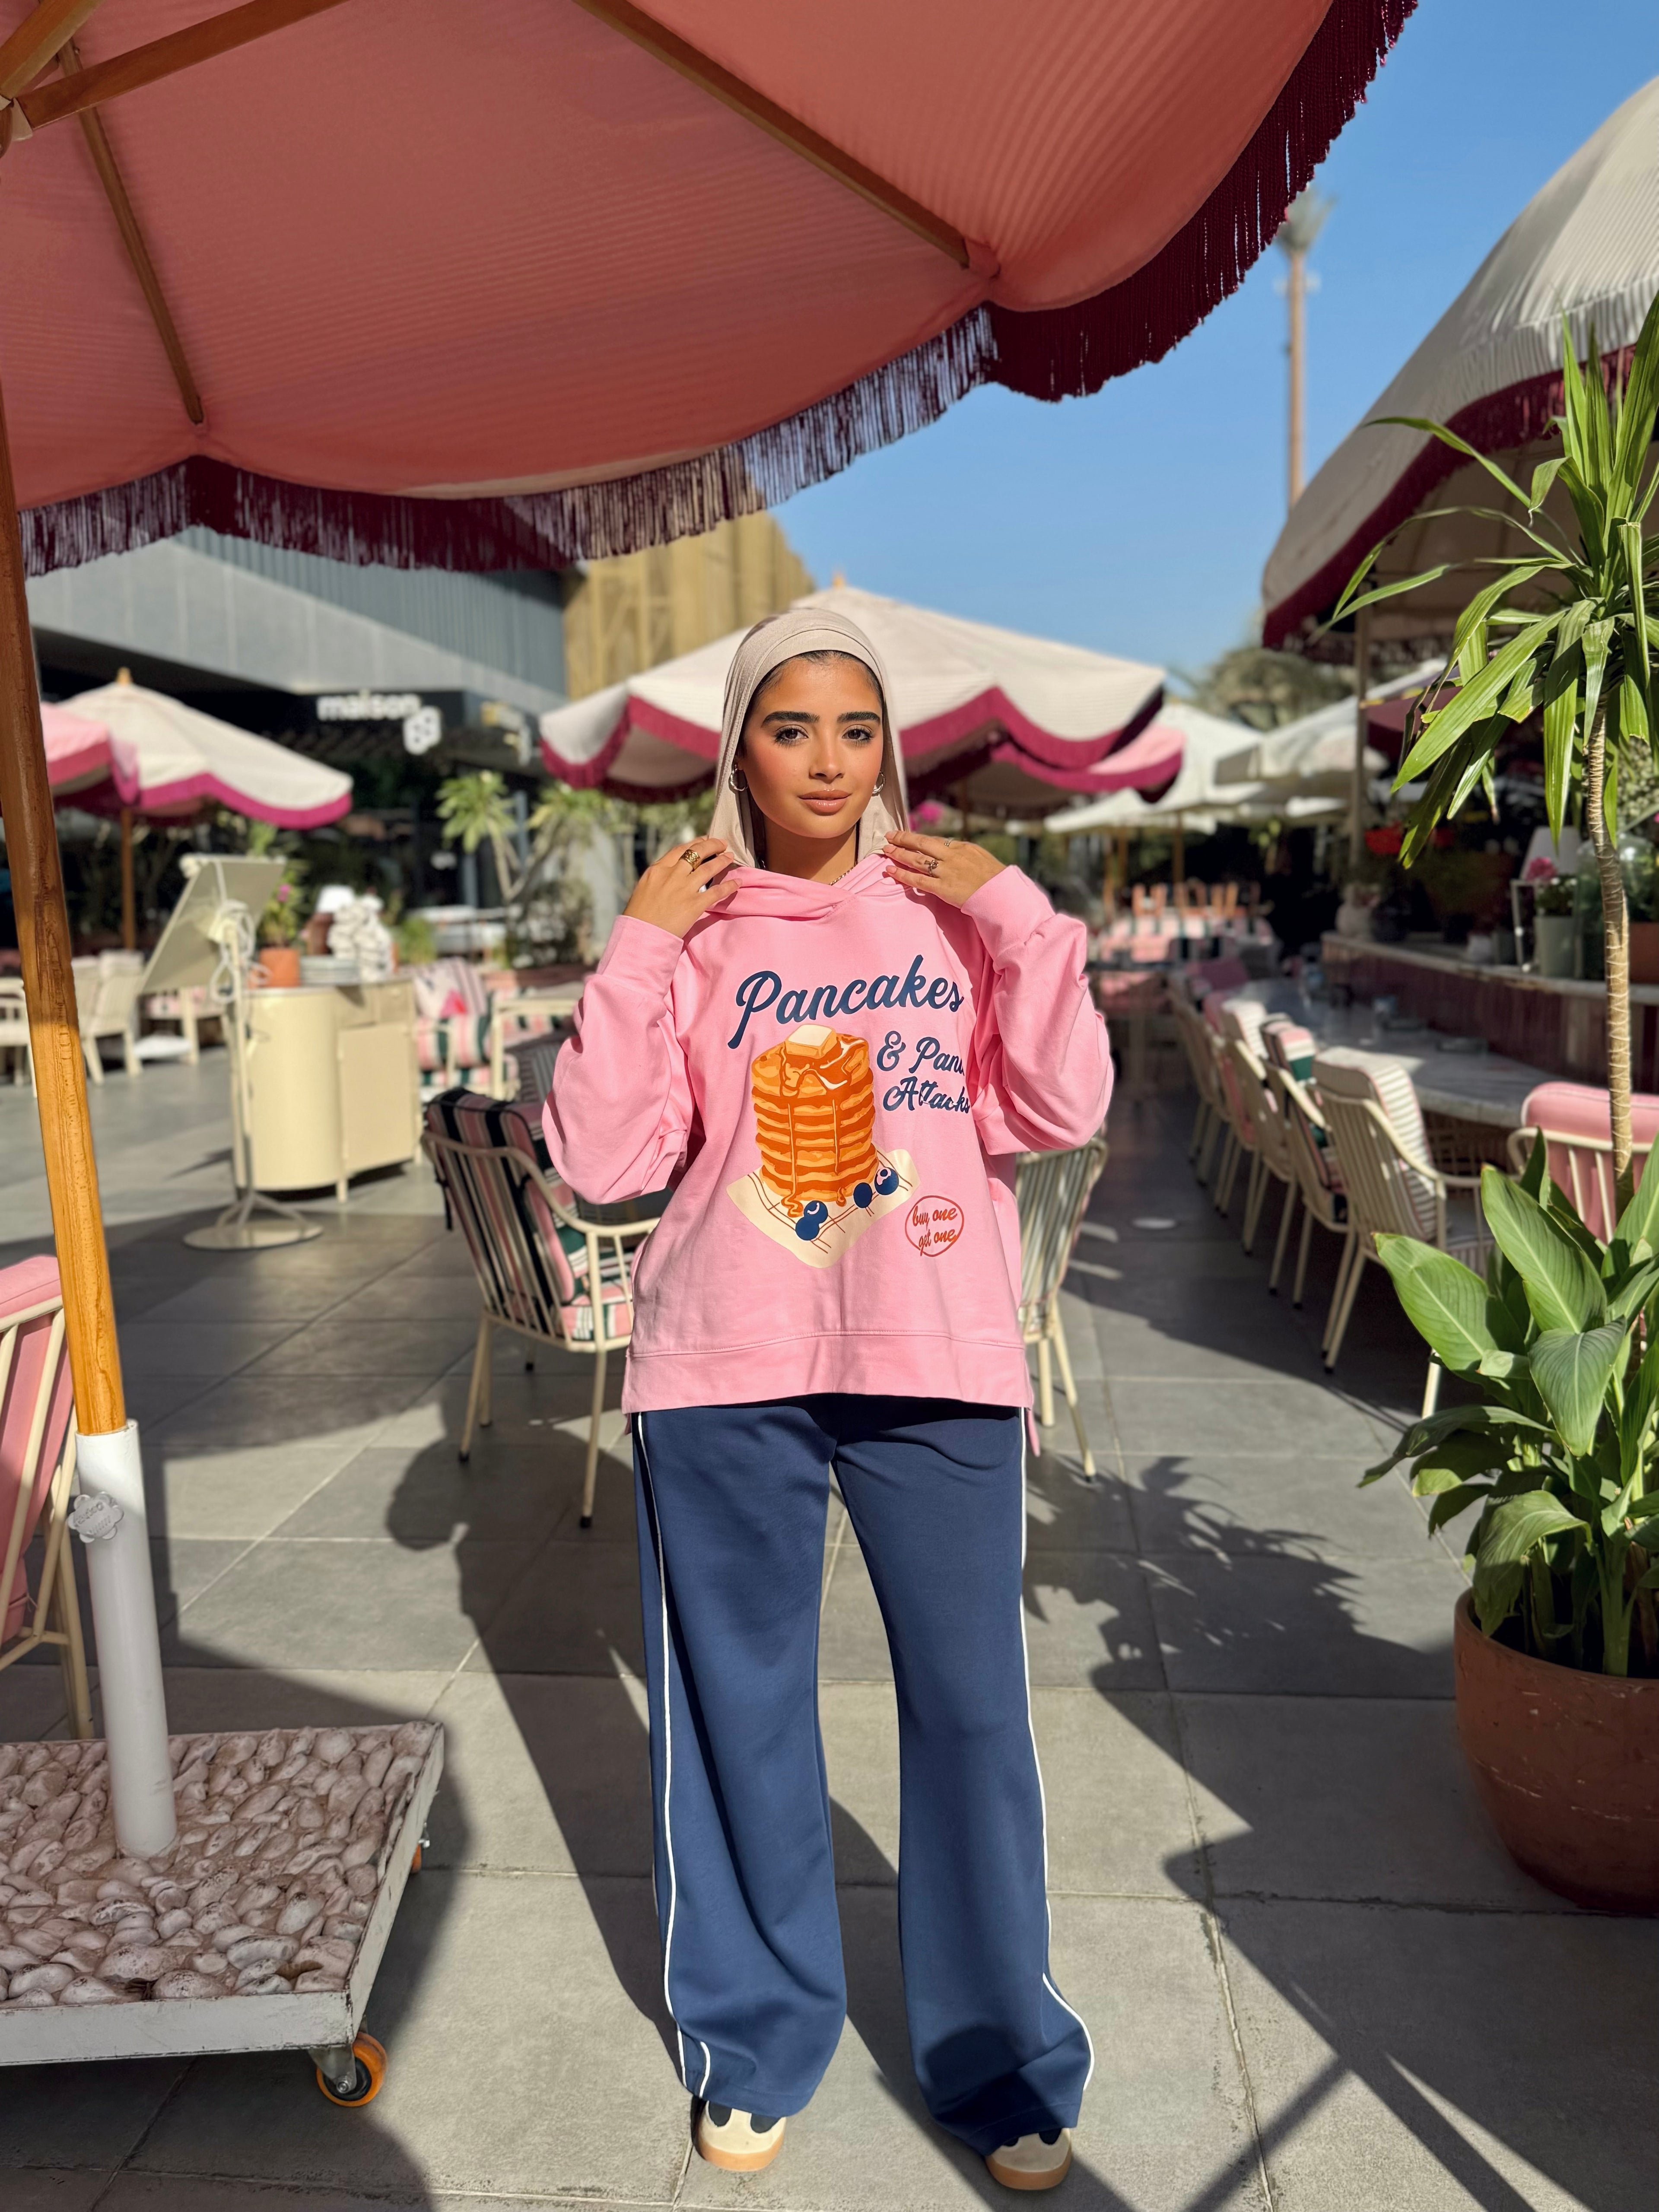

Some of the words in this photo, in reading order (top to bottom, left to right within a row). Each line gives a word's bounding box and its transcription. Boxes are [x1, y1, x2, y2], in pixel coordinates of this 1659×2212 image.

[728, 954, 964, 1049] Pancakes
[877, 1030, 906, 1071] &
[883, 1076, 970, 1114] Attacks
[912, 1205, 929, 1231] buy
[932, 1208, 957, 1221] one
[918, 1229, 931, 1256] get
[934, 1229, 956, 1243] one
